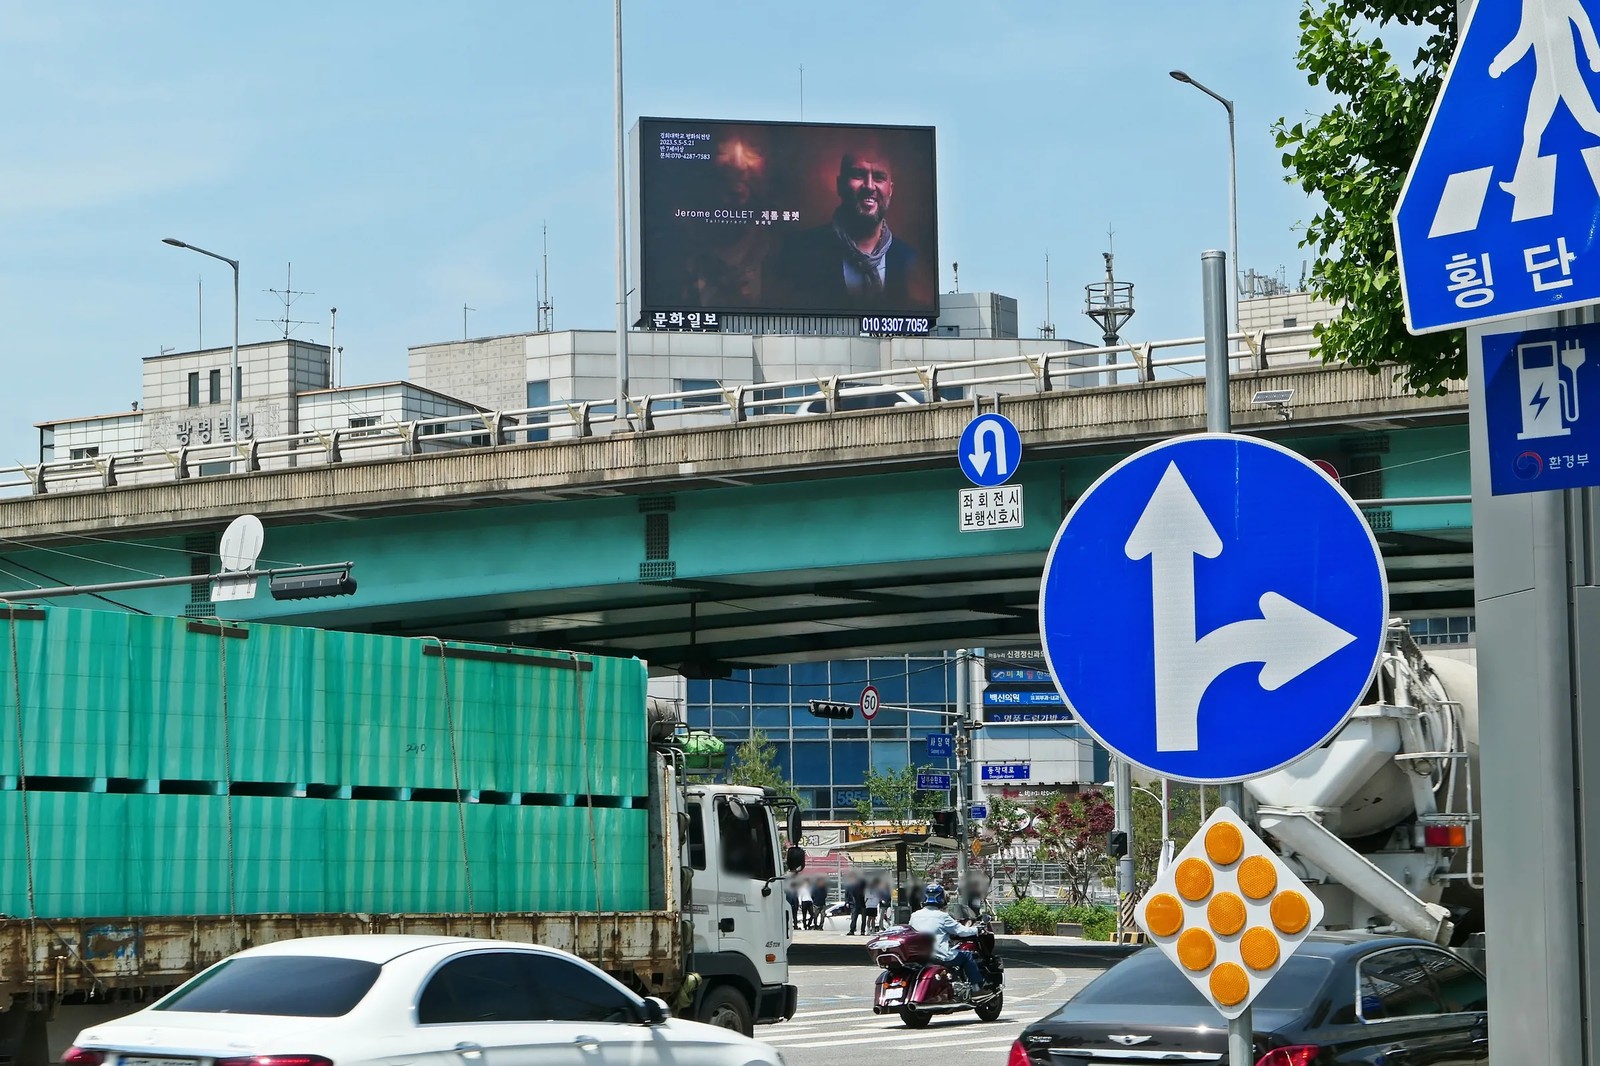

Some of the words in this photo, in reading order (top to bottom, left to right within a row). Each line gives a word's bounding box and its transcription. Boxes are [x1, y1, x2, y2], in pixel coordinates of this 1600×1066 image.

[675, 208, 711, 218] Jerome
[714, 209, 754, 219] COLLET
[653, 312, 719, 328] 문화일보
[862, 317, 880, 332] 010
[881, 318, 904, 332] 3307
[905, 318, 928, 332] 7052
[1549, 453, 1590, 470] 환경부
[963, 507, 1020, 527] 보행신호시
[864, 695, 876, 710] 50
[988, 766, 1015, 775] 동작대로
